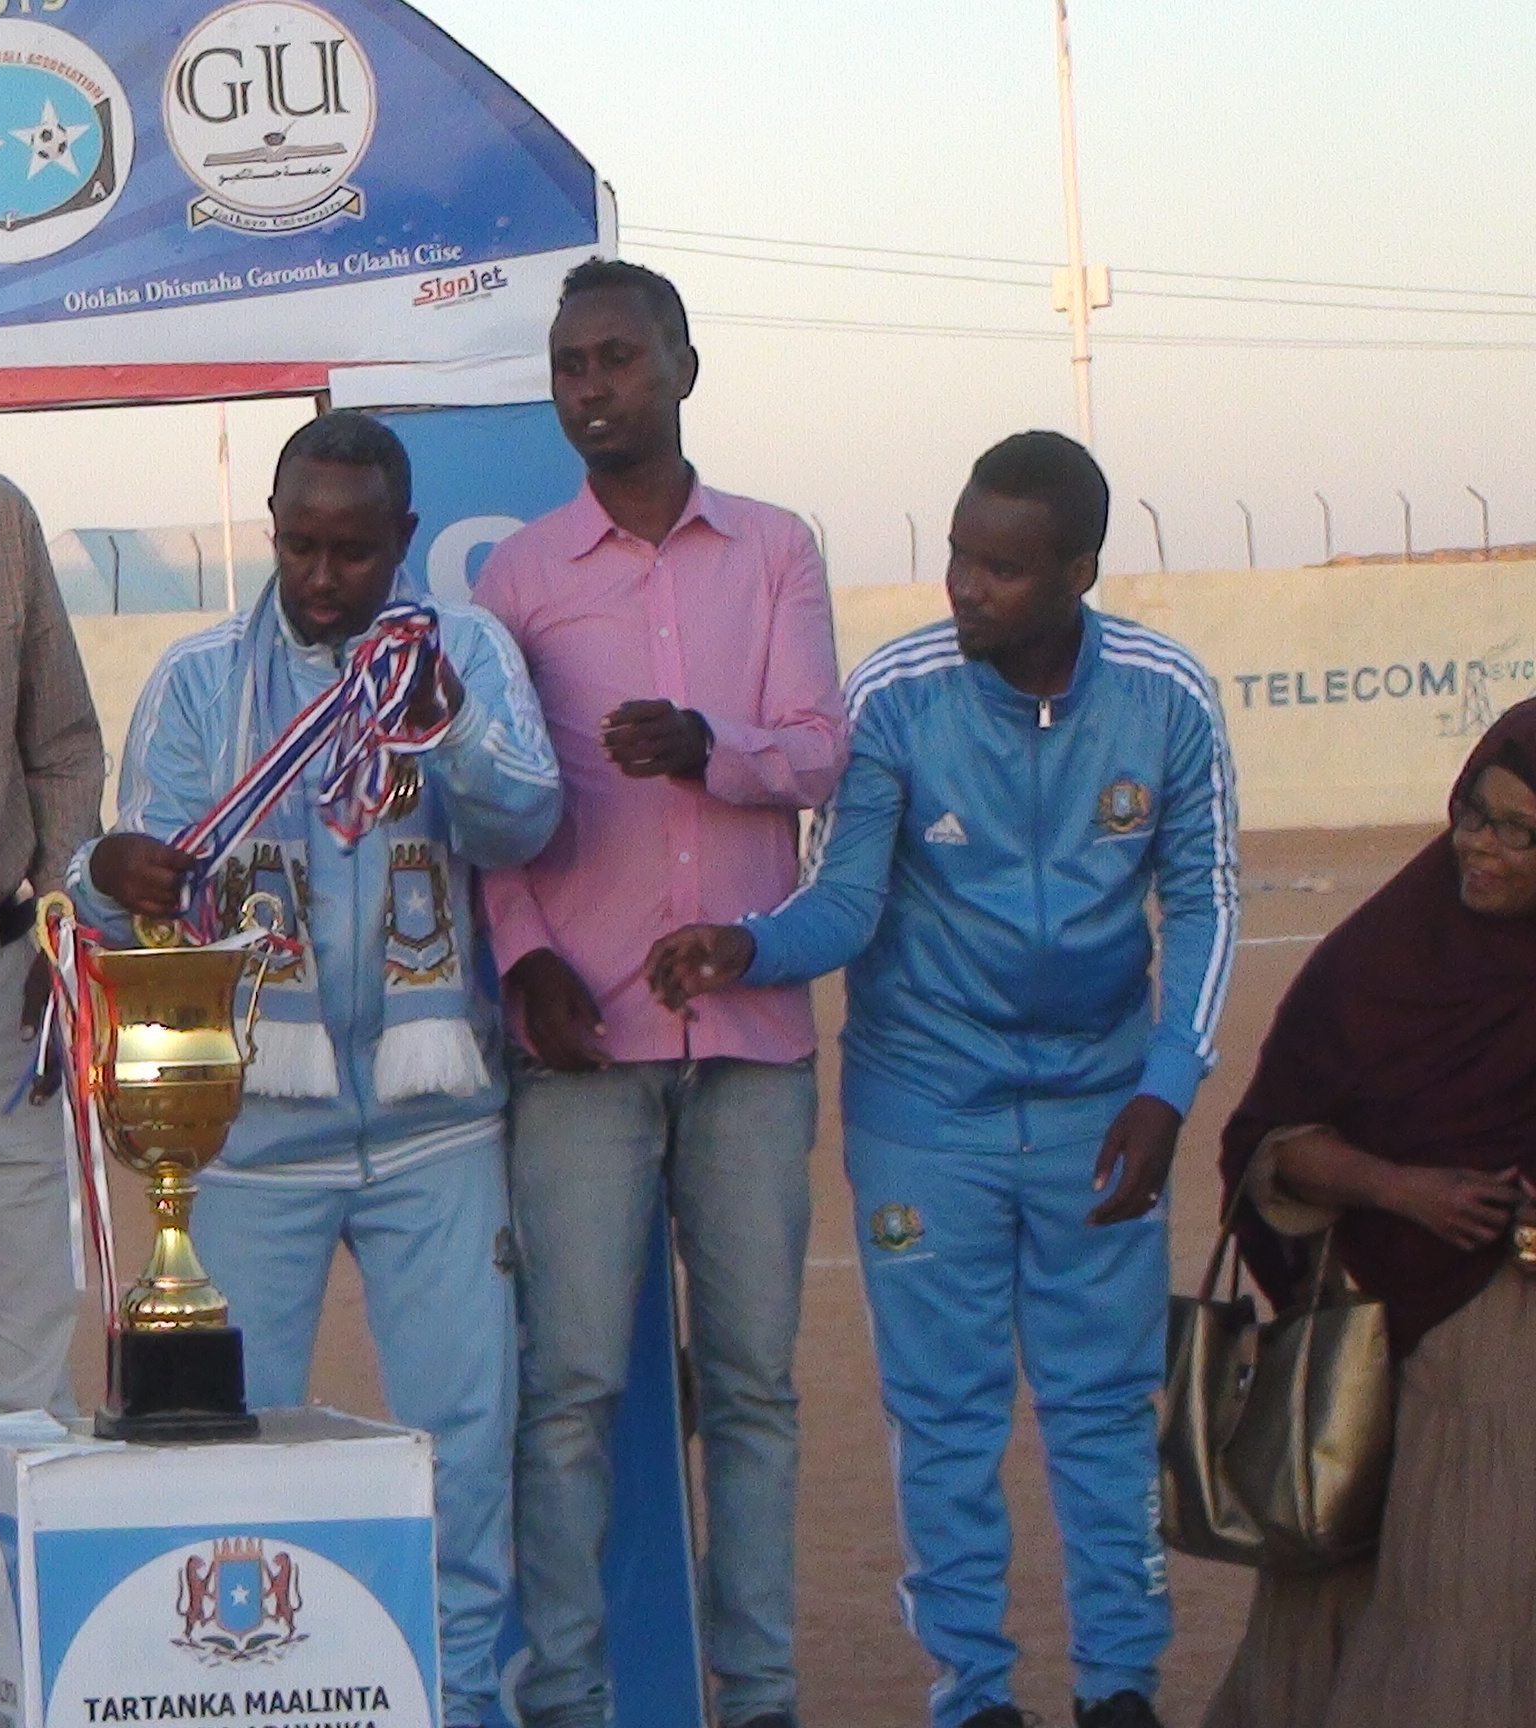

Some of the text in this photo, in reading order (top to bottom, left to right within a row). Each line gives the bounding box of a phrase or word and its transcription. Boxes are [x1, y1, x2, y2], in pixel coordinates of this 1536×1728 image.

[176, 39, 350, 123] GU
[65, 288, 141, 313] Ololaha
[144, 272, 244, 303] Dhismaha
[247, 258, 340, 289] Garoonka
[1235, 659, 1457, 708] TELECOM
[83, 1685, 390, 1723] TARTANKA MAALINTA
